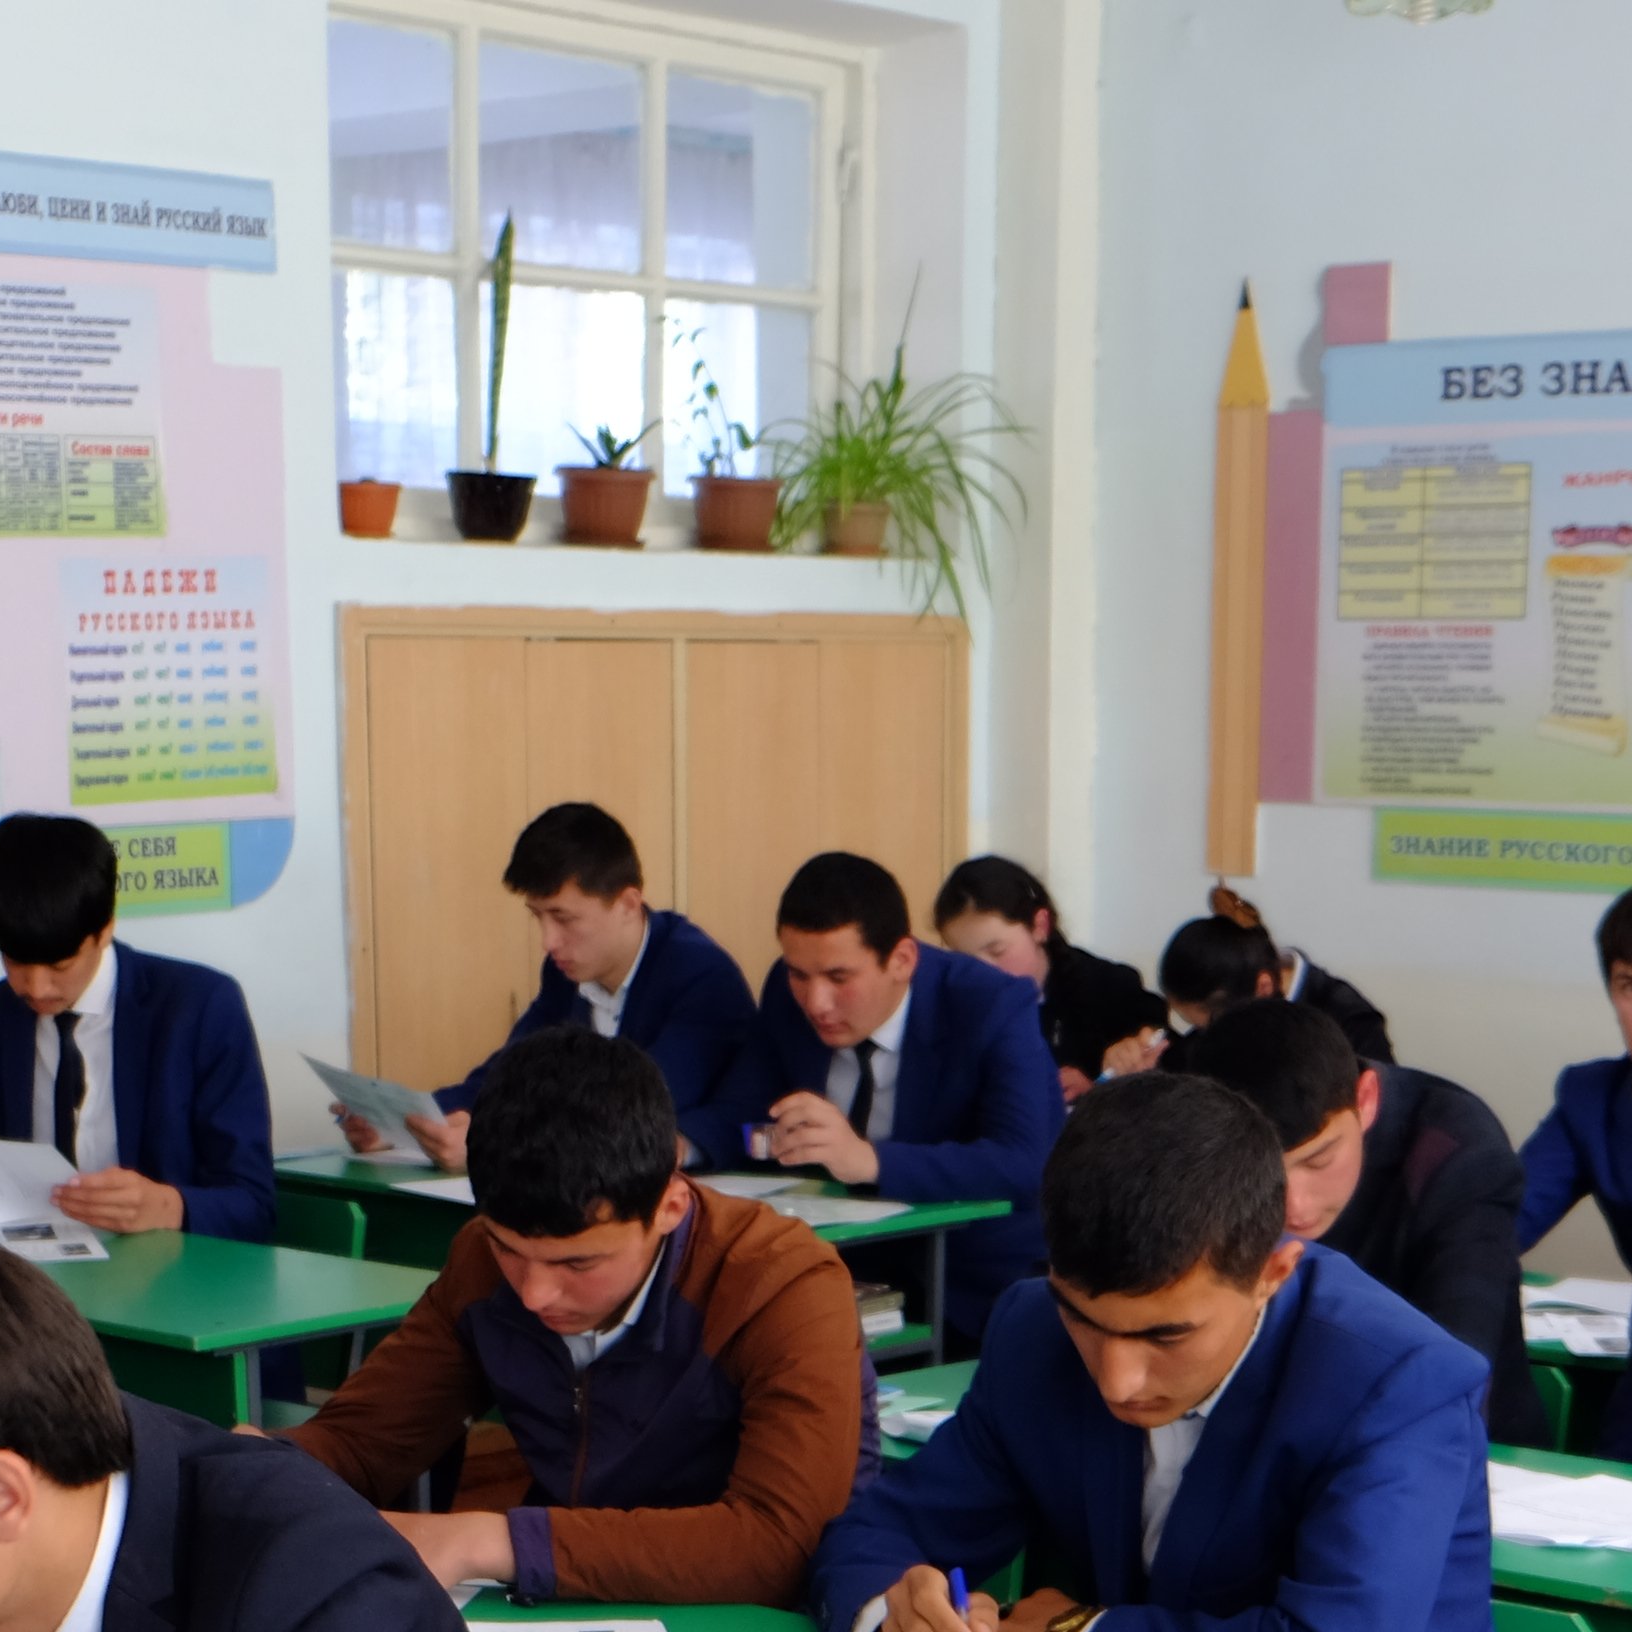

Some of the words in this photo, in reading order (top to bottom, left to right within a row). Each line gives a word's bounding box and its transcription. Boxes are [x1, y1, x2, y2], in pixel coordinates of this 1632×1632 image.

[47, 196, 92, 221] ЦЕНИ
[96, 201, 107, 222] И
[110, 200, 152, 227] ЗНАЙ
[155, 207, 223, 234] РУССКИЙ
[226, 214, 267, 239] ЯЗЫК
[1440, 363, 1524, 401] БЕЗ
[102, 568, 217, 596] ПАДЕЖИ
[78, 610, 179, 633] РУССКОГО
[186, 609, 256, 631] ЯЗЫКА
[127, 835, 177, 859] СЕБЯ
[1391, 835, 1490, 858] ЗНАНИЕ
[153, 867, 219, 890] ЯЗЫКА
